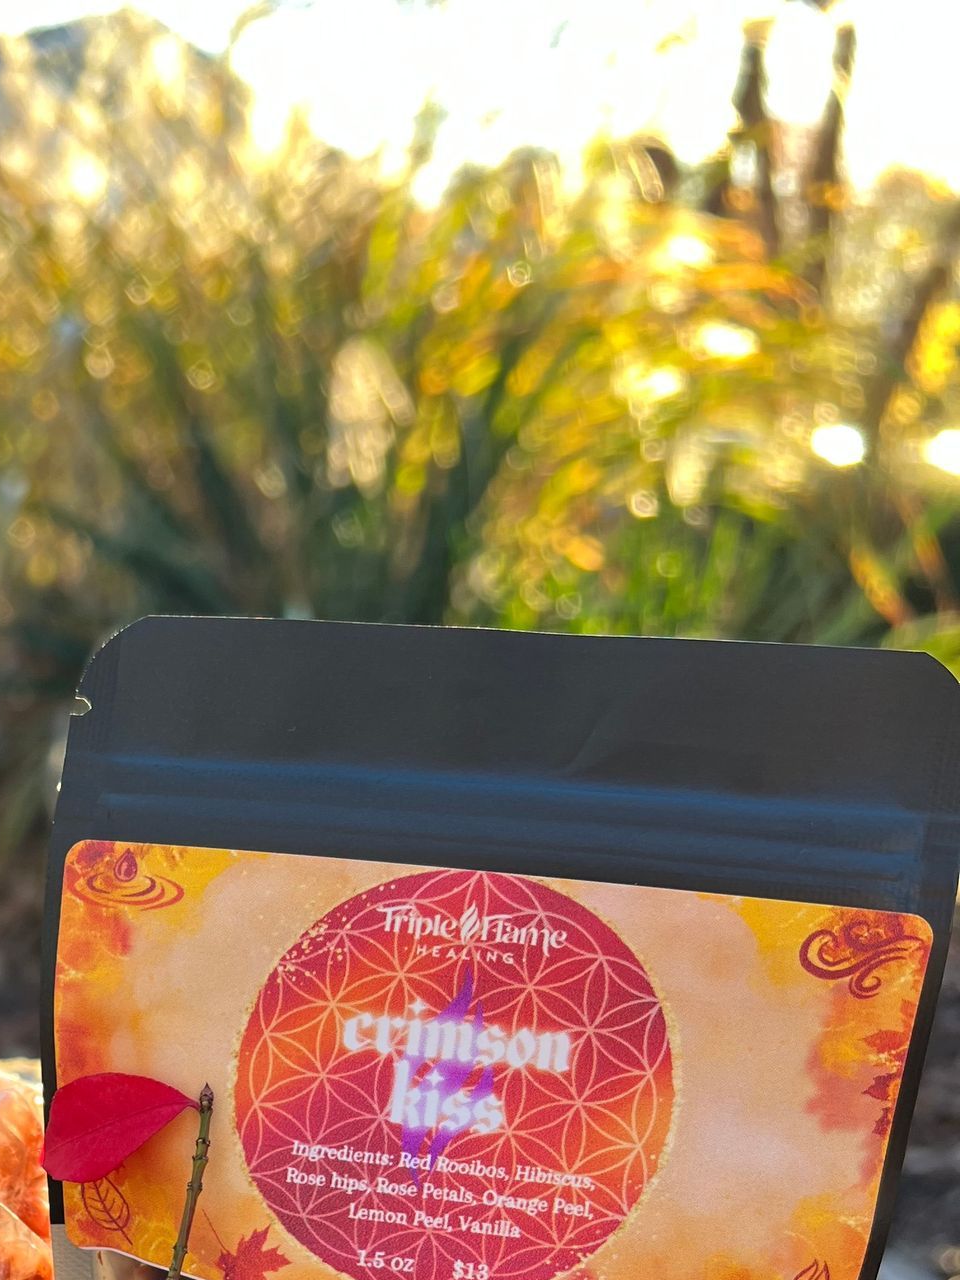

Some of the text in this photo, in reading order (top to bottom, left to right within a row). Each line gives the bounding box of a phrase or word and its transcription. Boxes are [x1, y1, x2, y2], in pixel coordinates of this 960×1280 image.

[376, 903, 568, 958] Triple Flame
[416, 944, 515, 965] HEALING
[343, 999, 571, 1073] crimson
[389, 1059, 504, 1133] kiss
[291, 1140, 595, 1191] Ingredients: Red Rooibos, Hibiscus,
[286, 1167, 594, 1220] Rose hips, Rose Petals, Orange Peel,
[348, 1202, 522, 1239] Lemon Peel, Vanilla
[356, 1249, 489, 1280] 1.5 oz $13
